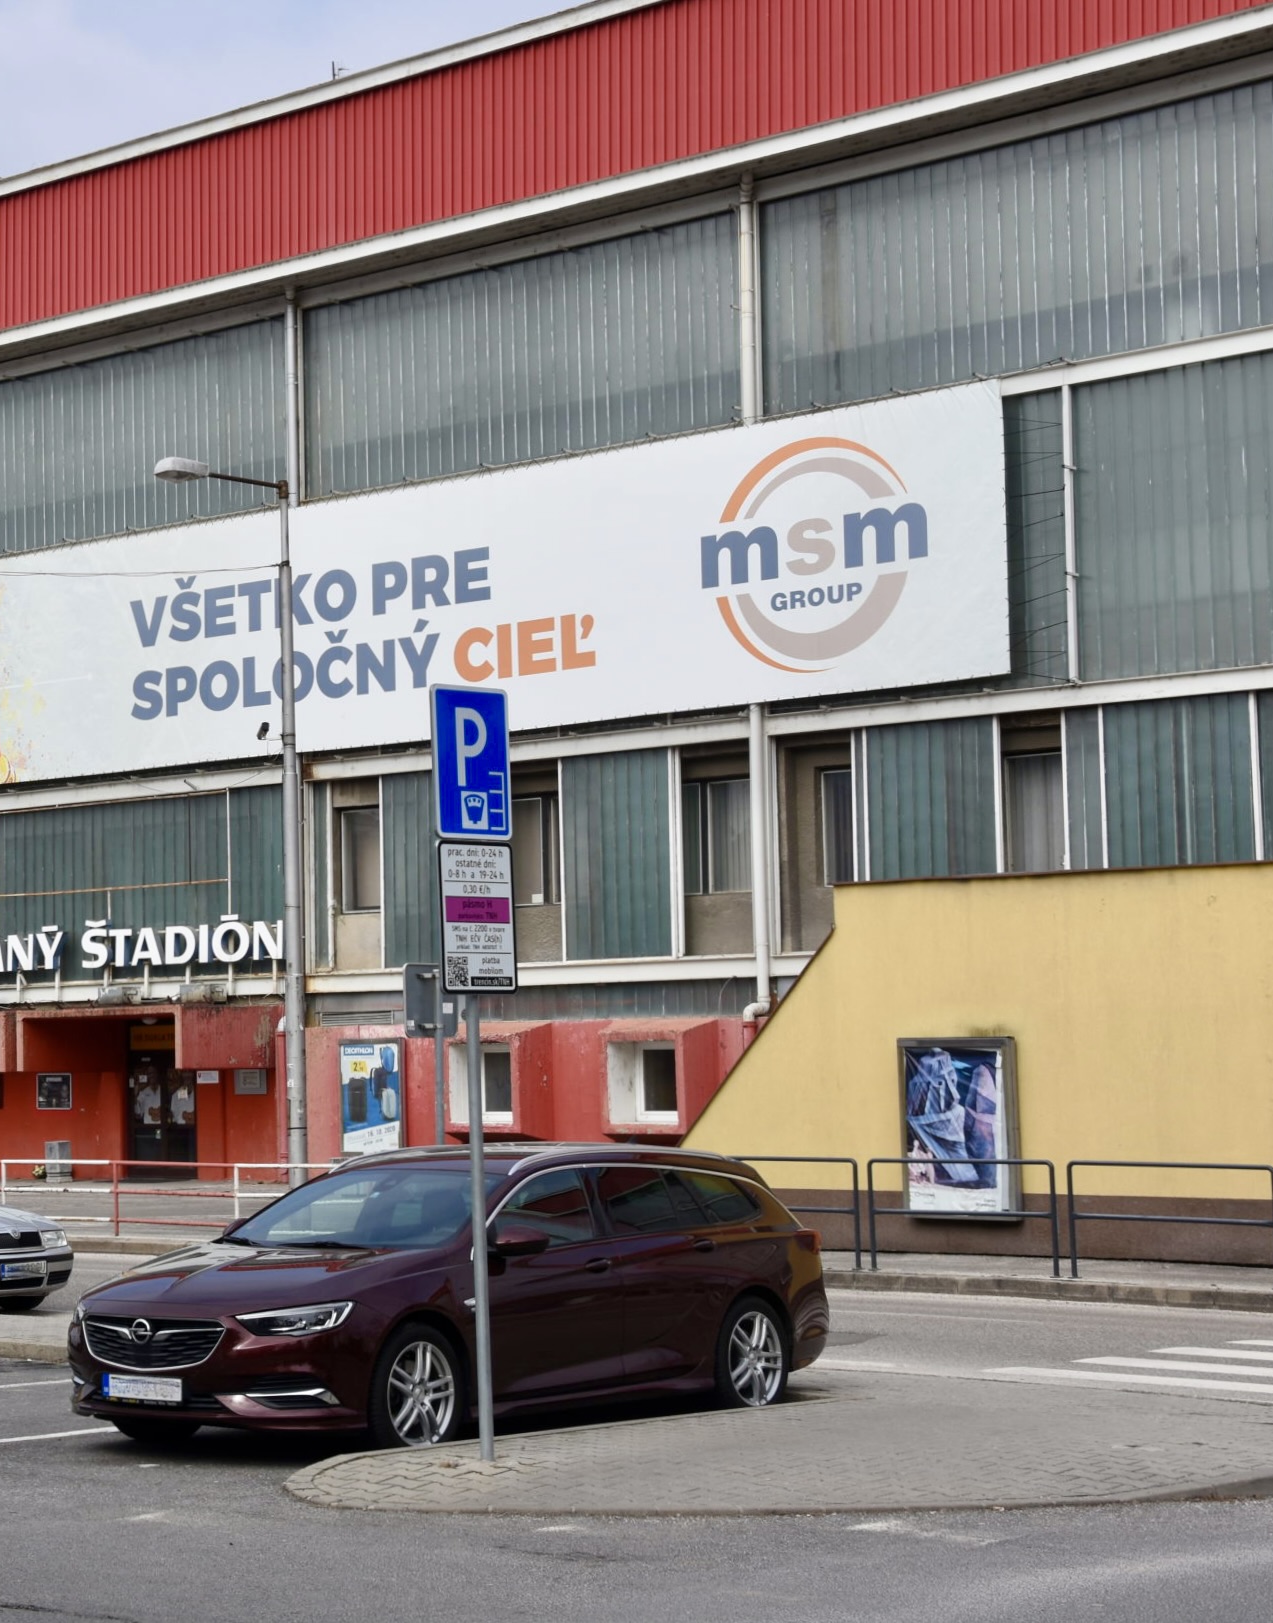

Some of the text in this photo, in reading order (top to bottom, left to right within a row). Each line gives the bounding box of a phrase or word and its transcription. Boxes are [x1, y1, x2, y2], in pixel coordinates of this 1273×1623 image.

[701, 502, 928, 589] msm
[130, 546, 491, 648] VŠETKO PRE
[770, 582, 863, 612] GROUP
[131, 613, 596, 721] SPOLOČNÝ CIEĽ
[455, 706, 487, 787] P
[447, 869, 460, 878] 0-8
[479, 870, 497, 879] 19-24
[481, 848, 497, 858] 0-24
[81, 914, 284, 969] ŠTADIÓN
[474, 924, 487, 932] 2200
[345, 1047, 373, 1055] DECATHLON
